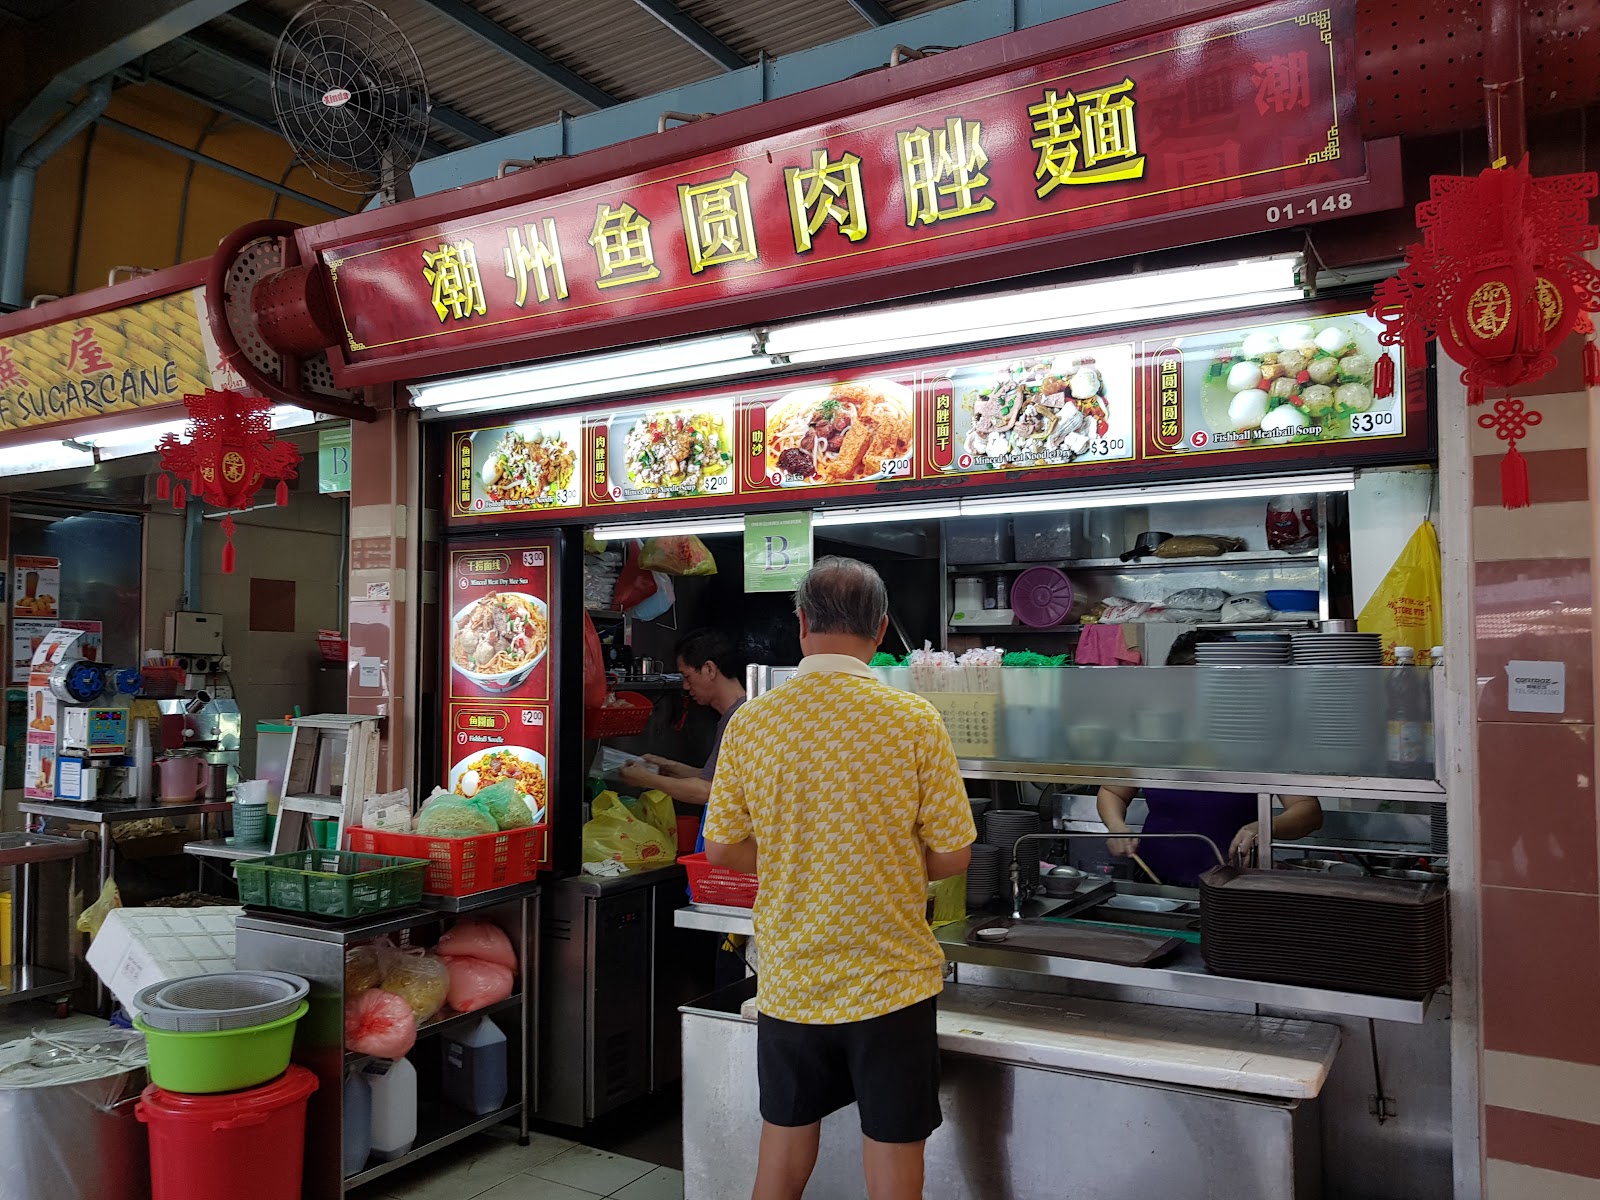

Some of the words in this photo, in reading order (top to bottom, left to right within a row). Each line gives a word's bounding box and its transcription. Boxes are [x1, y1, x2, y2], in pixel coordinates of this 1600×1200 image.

[1265, 192, 1353, 224] 01-148
[17, 361, 179, 421] SUGARCANE
[1161, 358, 1178, 437] 鱼圆肉圆汤
[1213, 430, 1251, 444] Fishball
[1252, 427, 1295, 441] Meatball
[1296, 424, 1323, 438] Soup
[331, 446, 349, 475] B
[974, 455, 1003, 465] Minced
[1004, 453, 1024, 463] Meat
[1025, 450, 1055, 461] Noodle
[1056, 449, 1071, 460] Dry
[660, 485, 681, 494] Noodle
[681, 484, 696, 493] Soup
[763, 536, 791, 571] B
